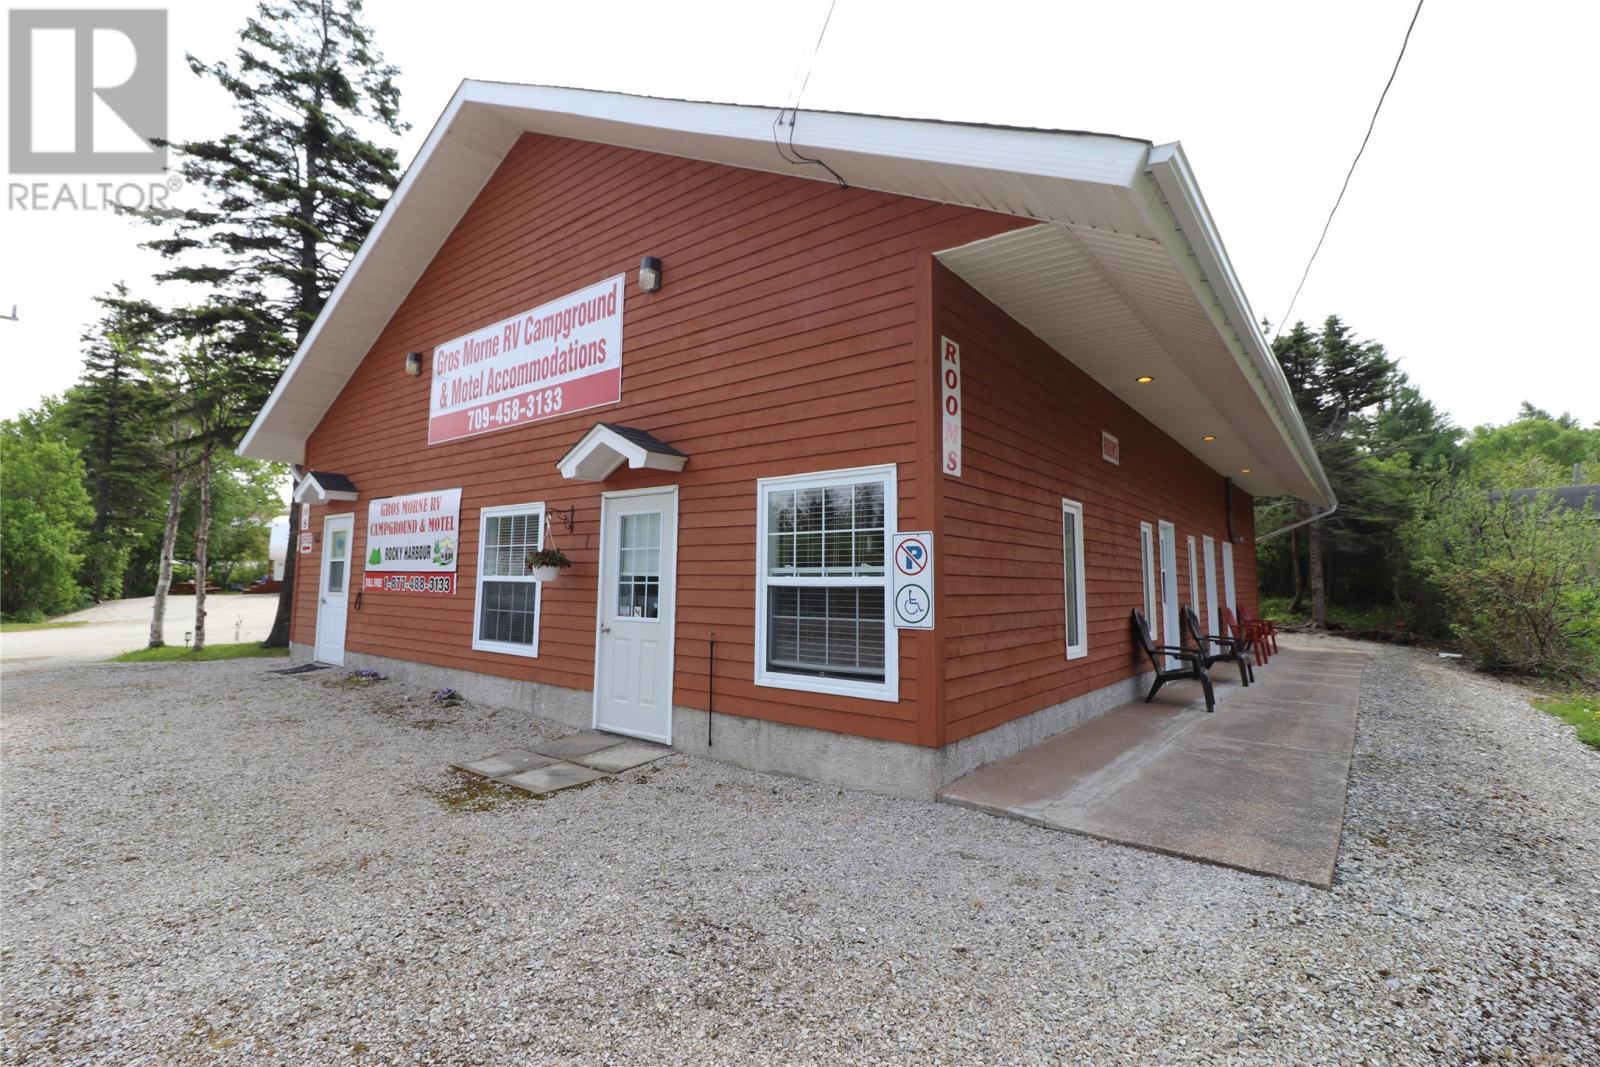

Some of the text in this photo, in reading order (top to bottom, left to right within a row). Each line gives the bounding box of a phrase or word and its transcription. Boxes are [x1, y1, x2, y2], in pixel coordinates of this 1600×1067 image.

[437, 283, 618, 376] Gros Morne RV Campground
[440, 337, 607, 409] & Motel Accommodations
[467, 387, 563, 431] 709-458-3133
[944, 342, 959, 471] ROOMS
[380, 496, 442, 517] GROS MORNE RV
[370, 516, 455, 536] CAMPGROUND & MOTEL
[385, 545, 432, 560] ROCKY HARBOUR
[383, 576, 450, 593] 1-877-488-3133
